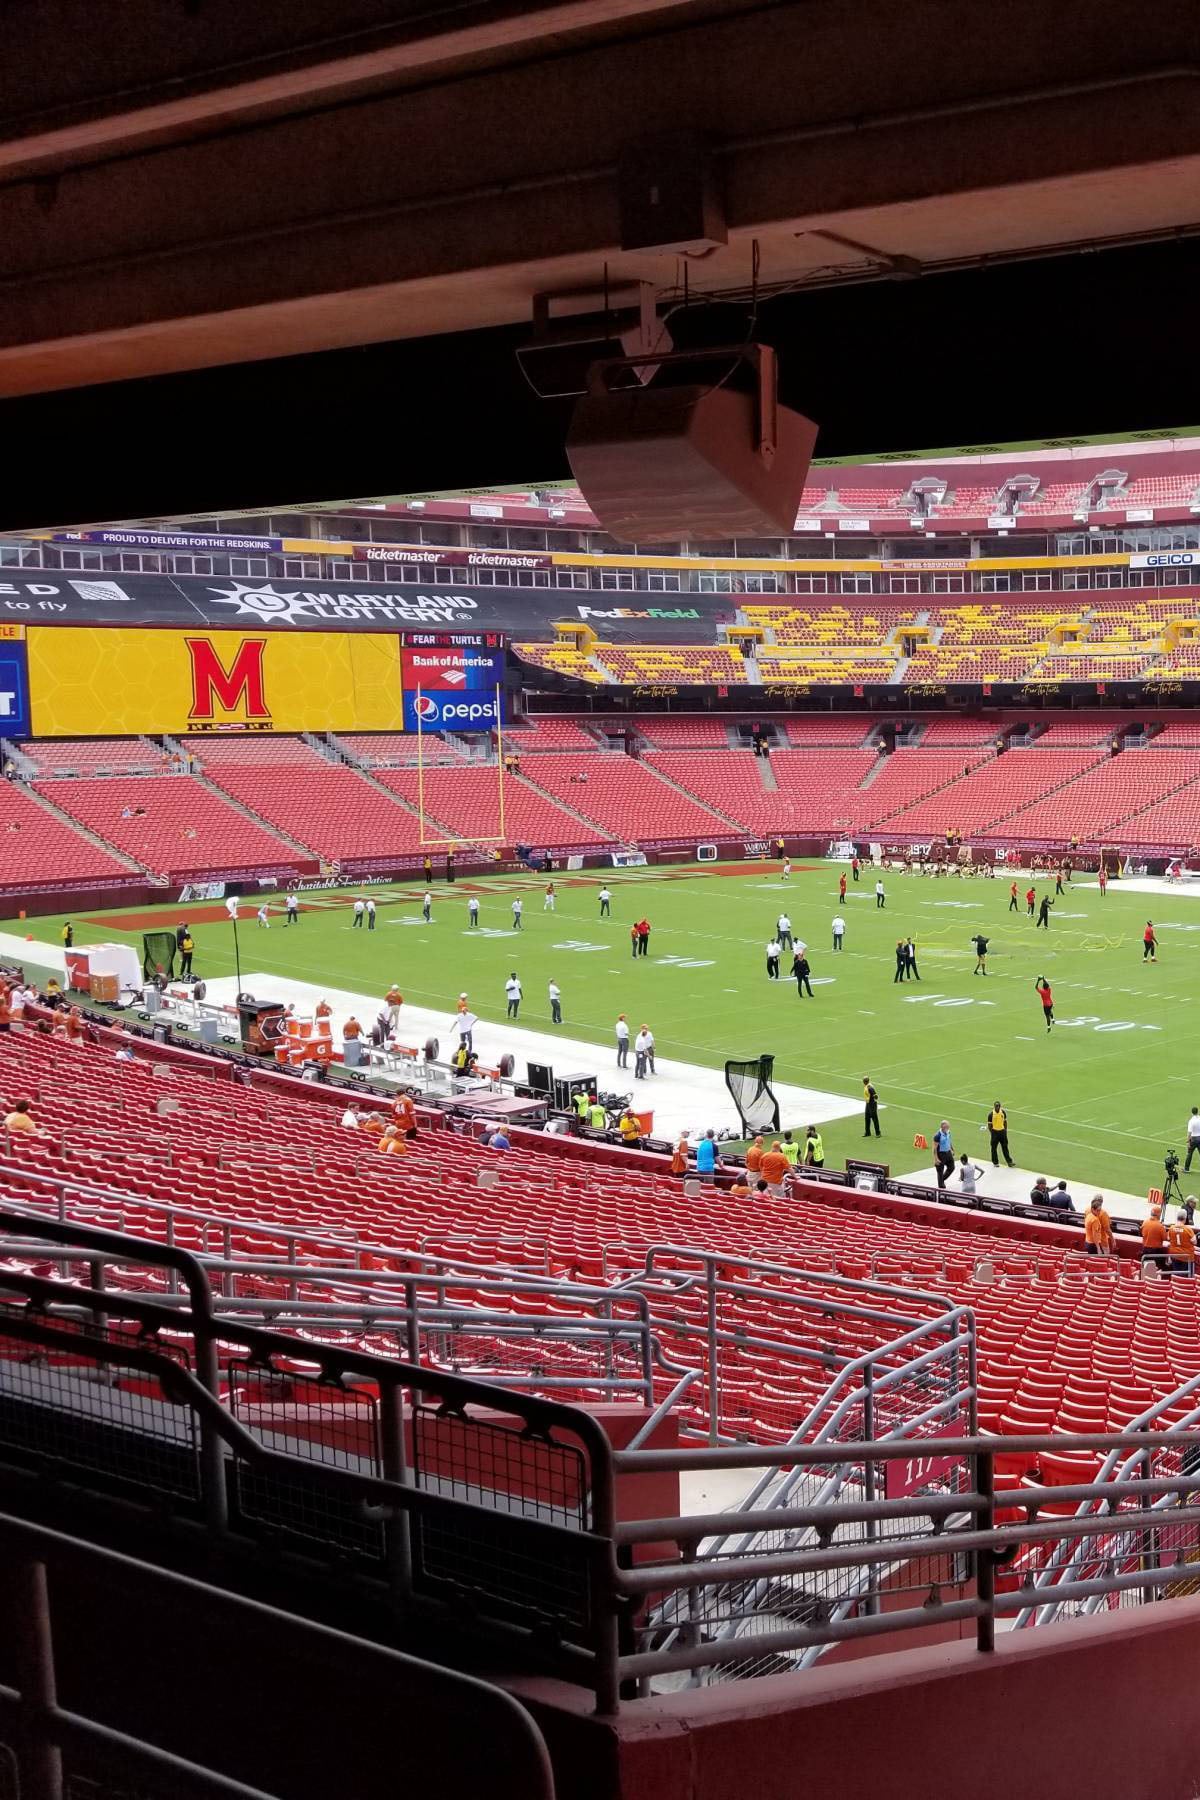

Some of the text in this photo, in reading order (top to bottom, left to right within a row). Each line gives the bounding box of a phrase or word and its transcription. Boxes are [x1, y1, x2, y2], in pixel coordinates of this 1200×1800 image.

[103, 533, 272, 549] PROUD TO DELIVER FOR THE REDSKINS.
[366, 548, 442, 563] ticketmaster
[468, 553, 539, 567] ticketmaster
[1147, 554, 1193, 566] GEICO
[5, 601, 68, 613] to fly
[300, 592, 478, 610] MARYLAND
[313, 605, 456, 622] LOTTERY
[578, 605, 700, 620] FedExField
[412, 655, 493, 667] Bank of America
[442, 700, 498, 721] pepsi
[1149, 1189, 1159, 1204] 10
